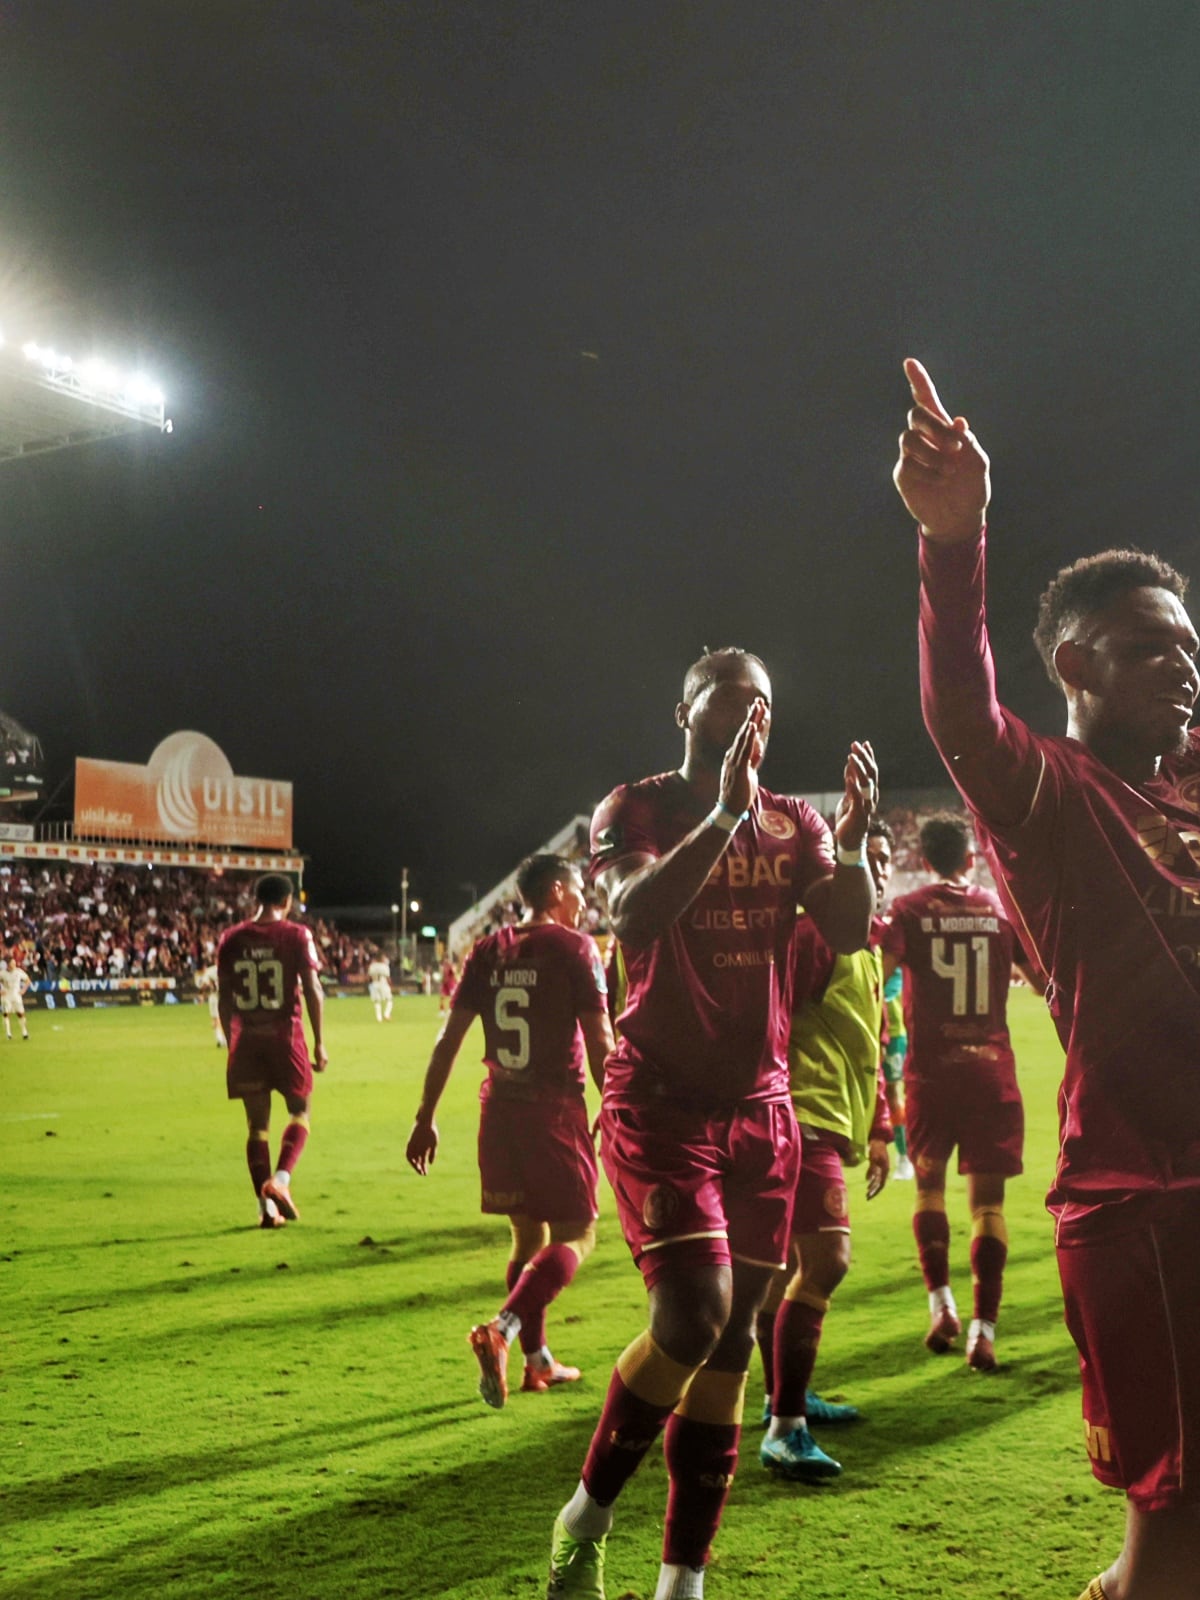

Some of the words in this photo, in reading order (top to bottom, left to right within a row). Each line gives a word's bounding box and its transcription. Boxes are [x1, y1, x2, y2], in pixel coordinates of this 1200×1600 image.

[203, 777, 285, 816] UISIL
[727, 853, 793, 888] BAC
[234, 960, 284, 1010] 33
[503, 969, 538, 987] MORA
[931, 936, 989, 1016] 41
[494, 987, 530, 1070] 5
